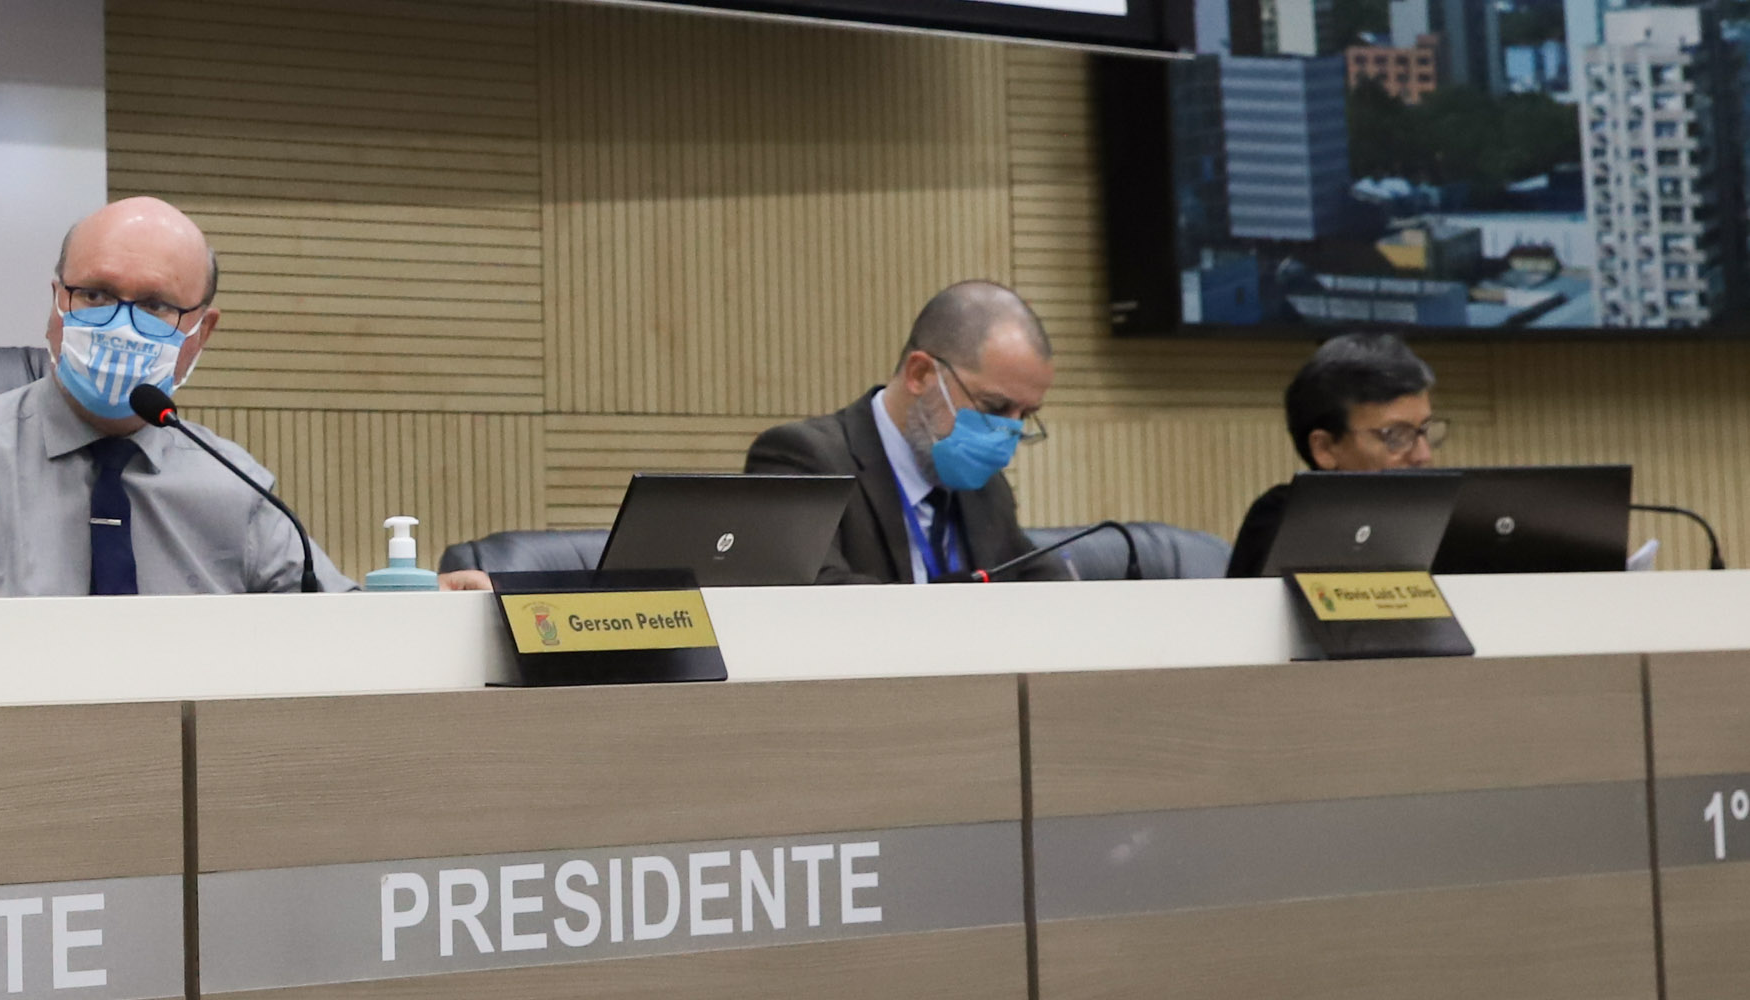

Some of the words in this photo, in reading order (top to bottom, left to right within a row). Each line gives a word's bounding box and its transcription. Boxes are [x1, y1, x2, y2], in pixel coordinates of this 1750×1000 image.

[568, 614, 633, 632] Gerson
[636, 611, 694, 629] Peteffi
[381, 841, 882, 961] PRESIDENTE
